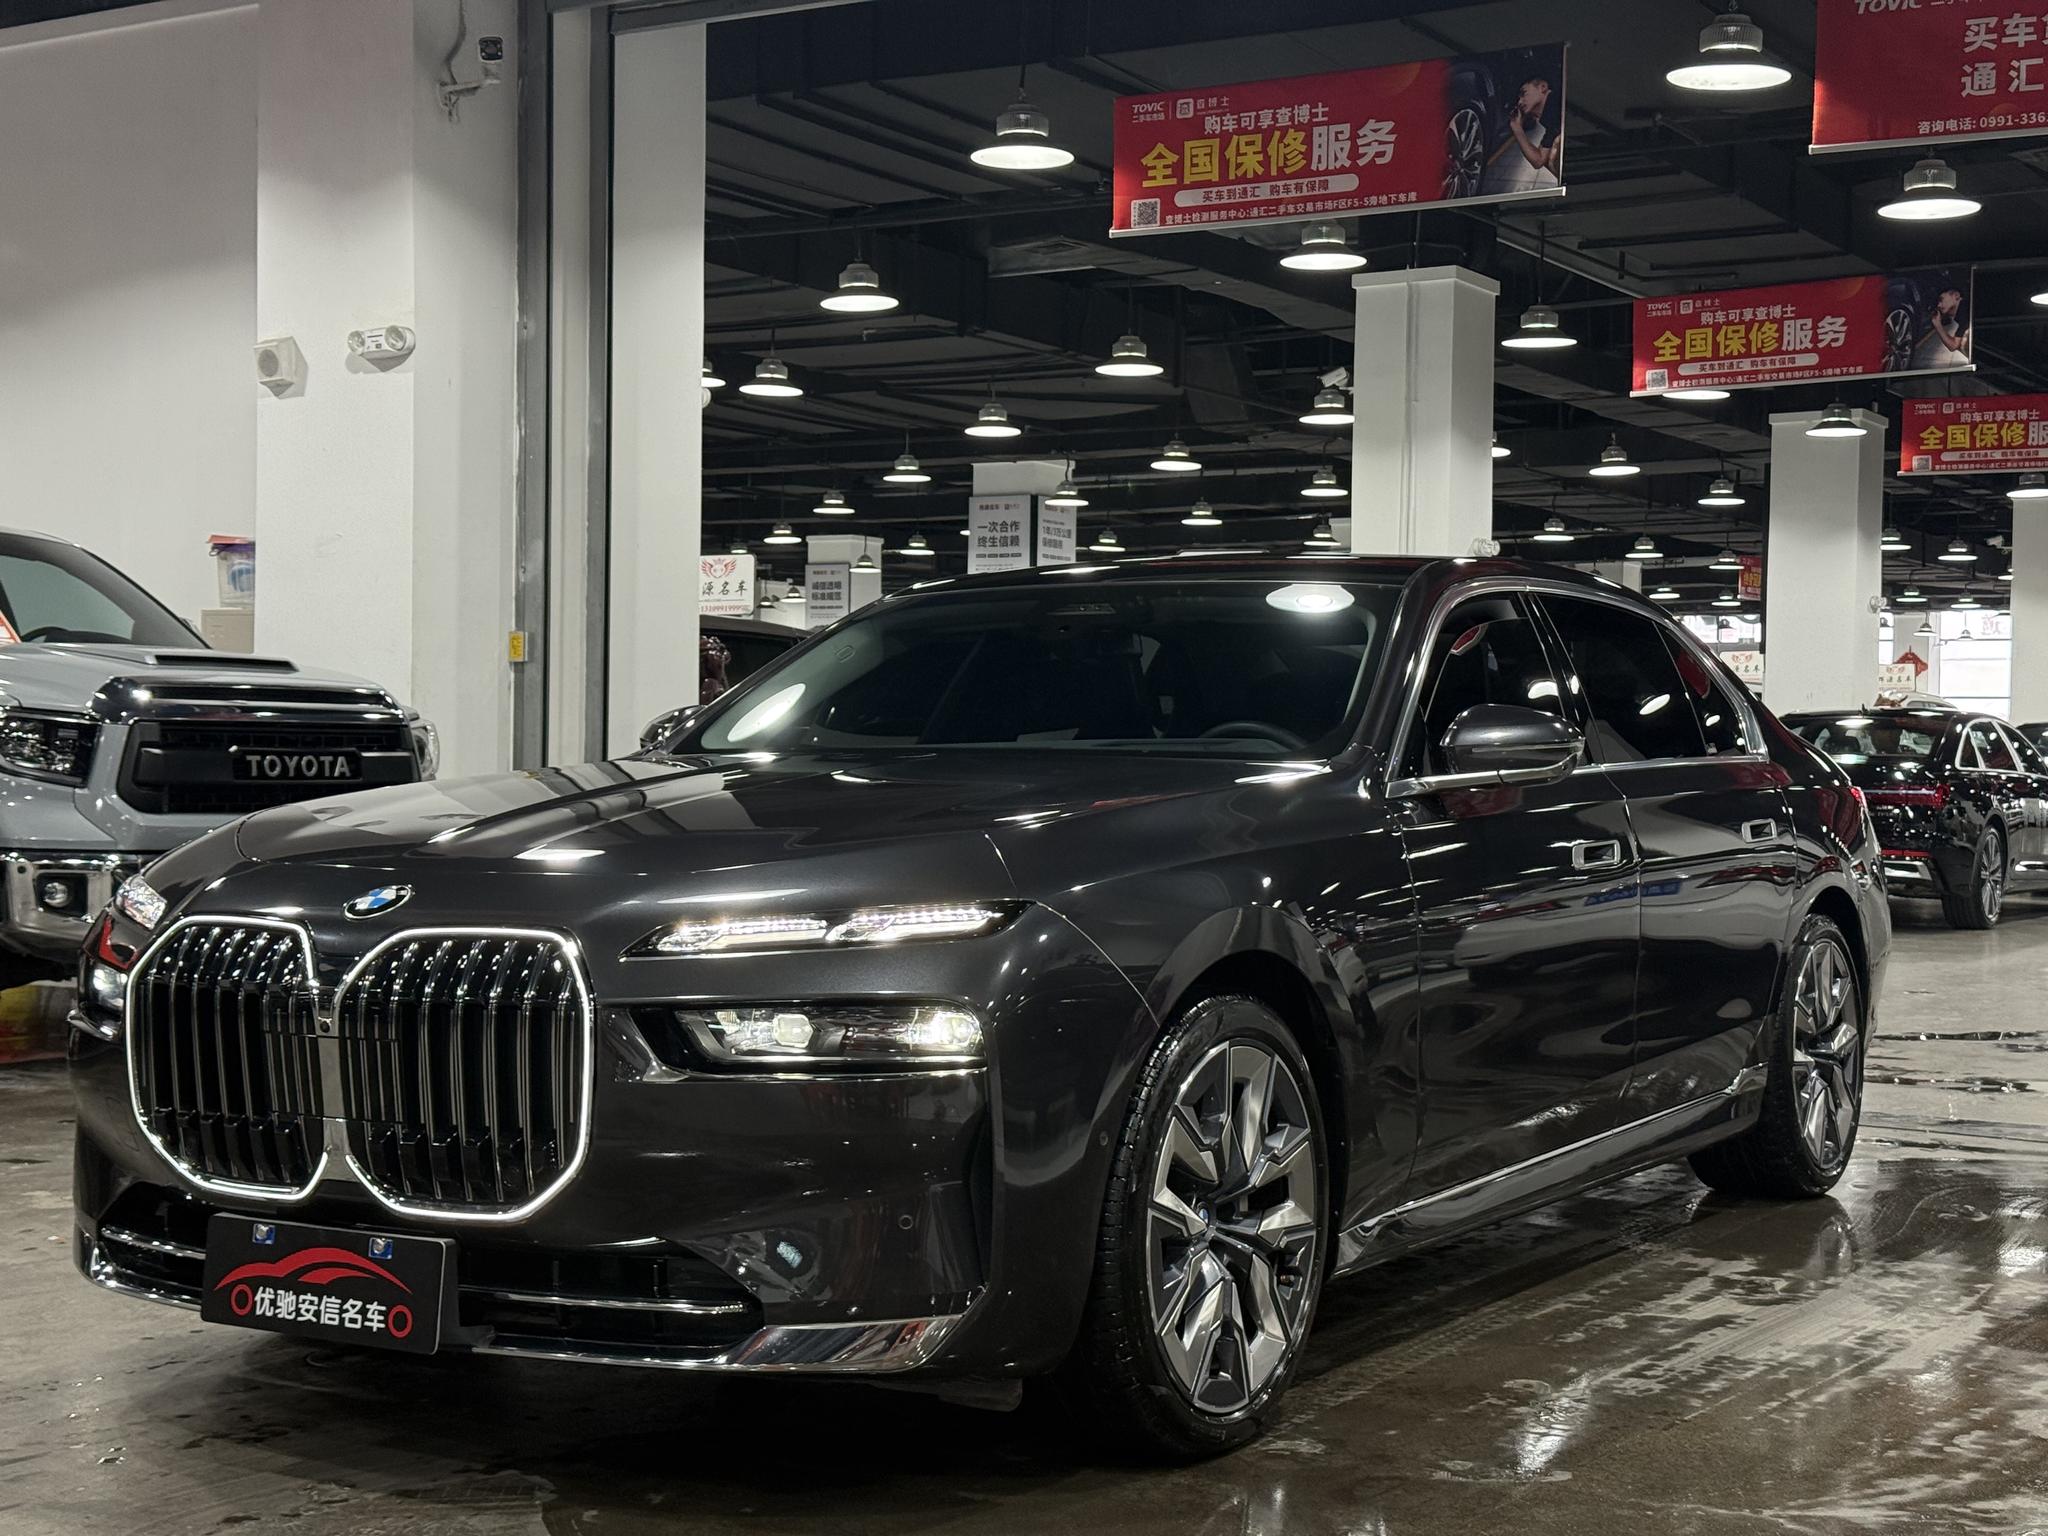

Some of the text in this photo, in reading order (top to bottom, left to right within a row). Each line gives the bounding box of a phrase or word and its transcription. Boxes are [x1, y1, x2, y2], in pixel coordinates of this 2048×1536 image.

[1963, 12, 2048, 53] 买车
[1961, 57, 2045, 98] 通汇
[1131, 101, 1165, 114] TOVIC
[1204, 103, 1329, 134] 购车可享查博士
[1979, 111, 2048, 129] 0991-336
[1140, 119, 1398, 188] 全国保修服务
[1202, 179, 1330, 203] 买车到通汇 购车有保障
[1700, 303, 1797, 326] 购车可享查博士
[1652, 316, 1850, 363] 全国保修服务
[977, 520, 1020, 533] 一次合作
[977, 535, 1020, 548] 终生信赖
[246, 754, 351, 778] TOYOTA
[254, 1285, 387, 1333] 优驰安信名车
